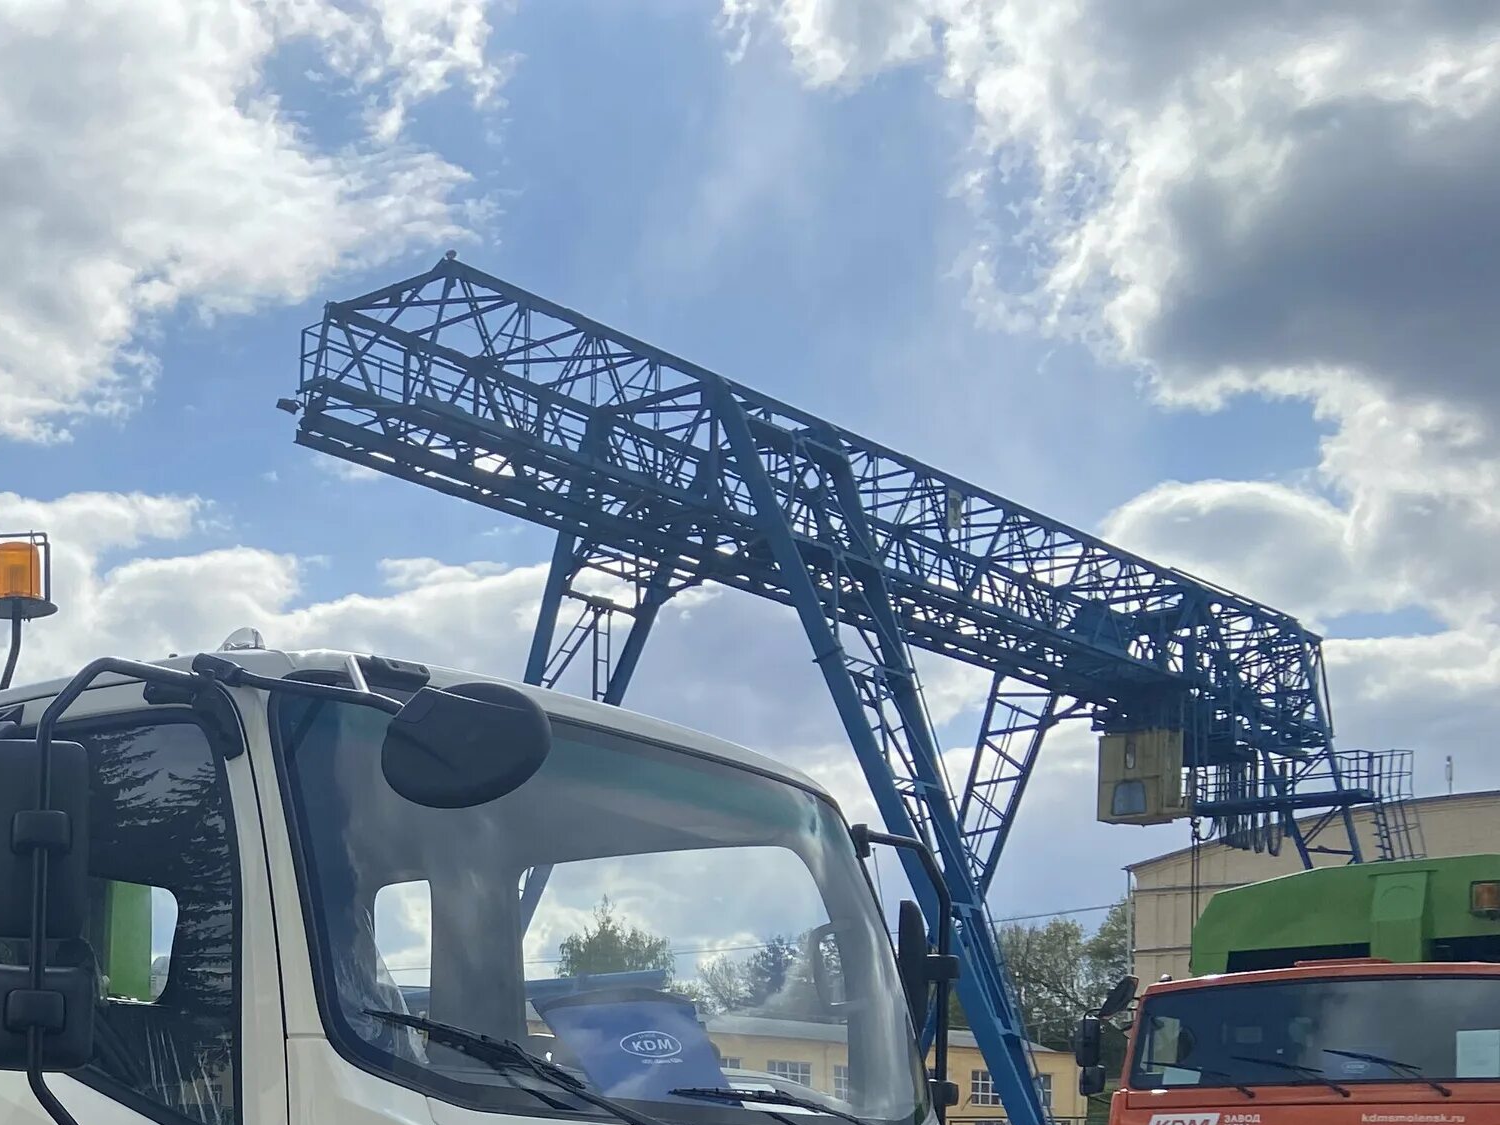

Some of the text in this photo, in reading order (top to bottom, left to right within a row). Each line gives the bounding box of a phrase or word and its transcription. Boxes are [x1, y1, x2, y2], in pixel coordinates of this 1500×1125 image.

[631, 1038, 674, 1051] KDM
[1223, 1114, 1261, 1124] ЗАВОД
[1361, 1113, 1465, 1123] kdmsmolensk.ru
